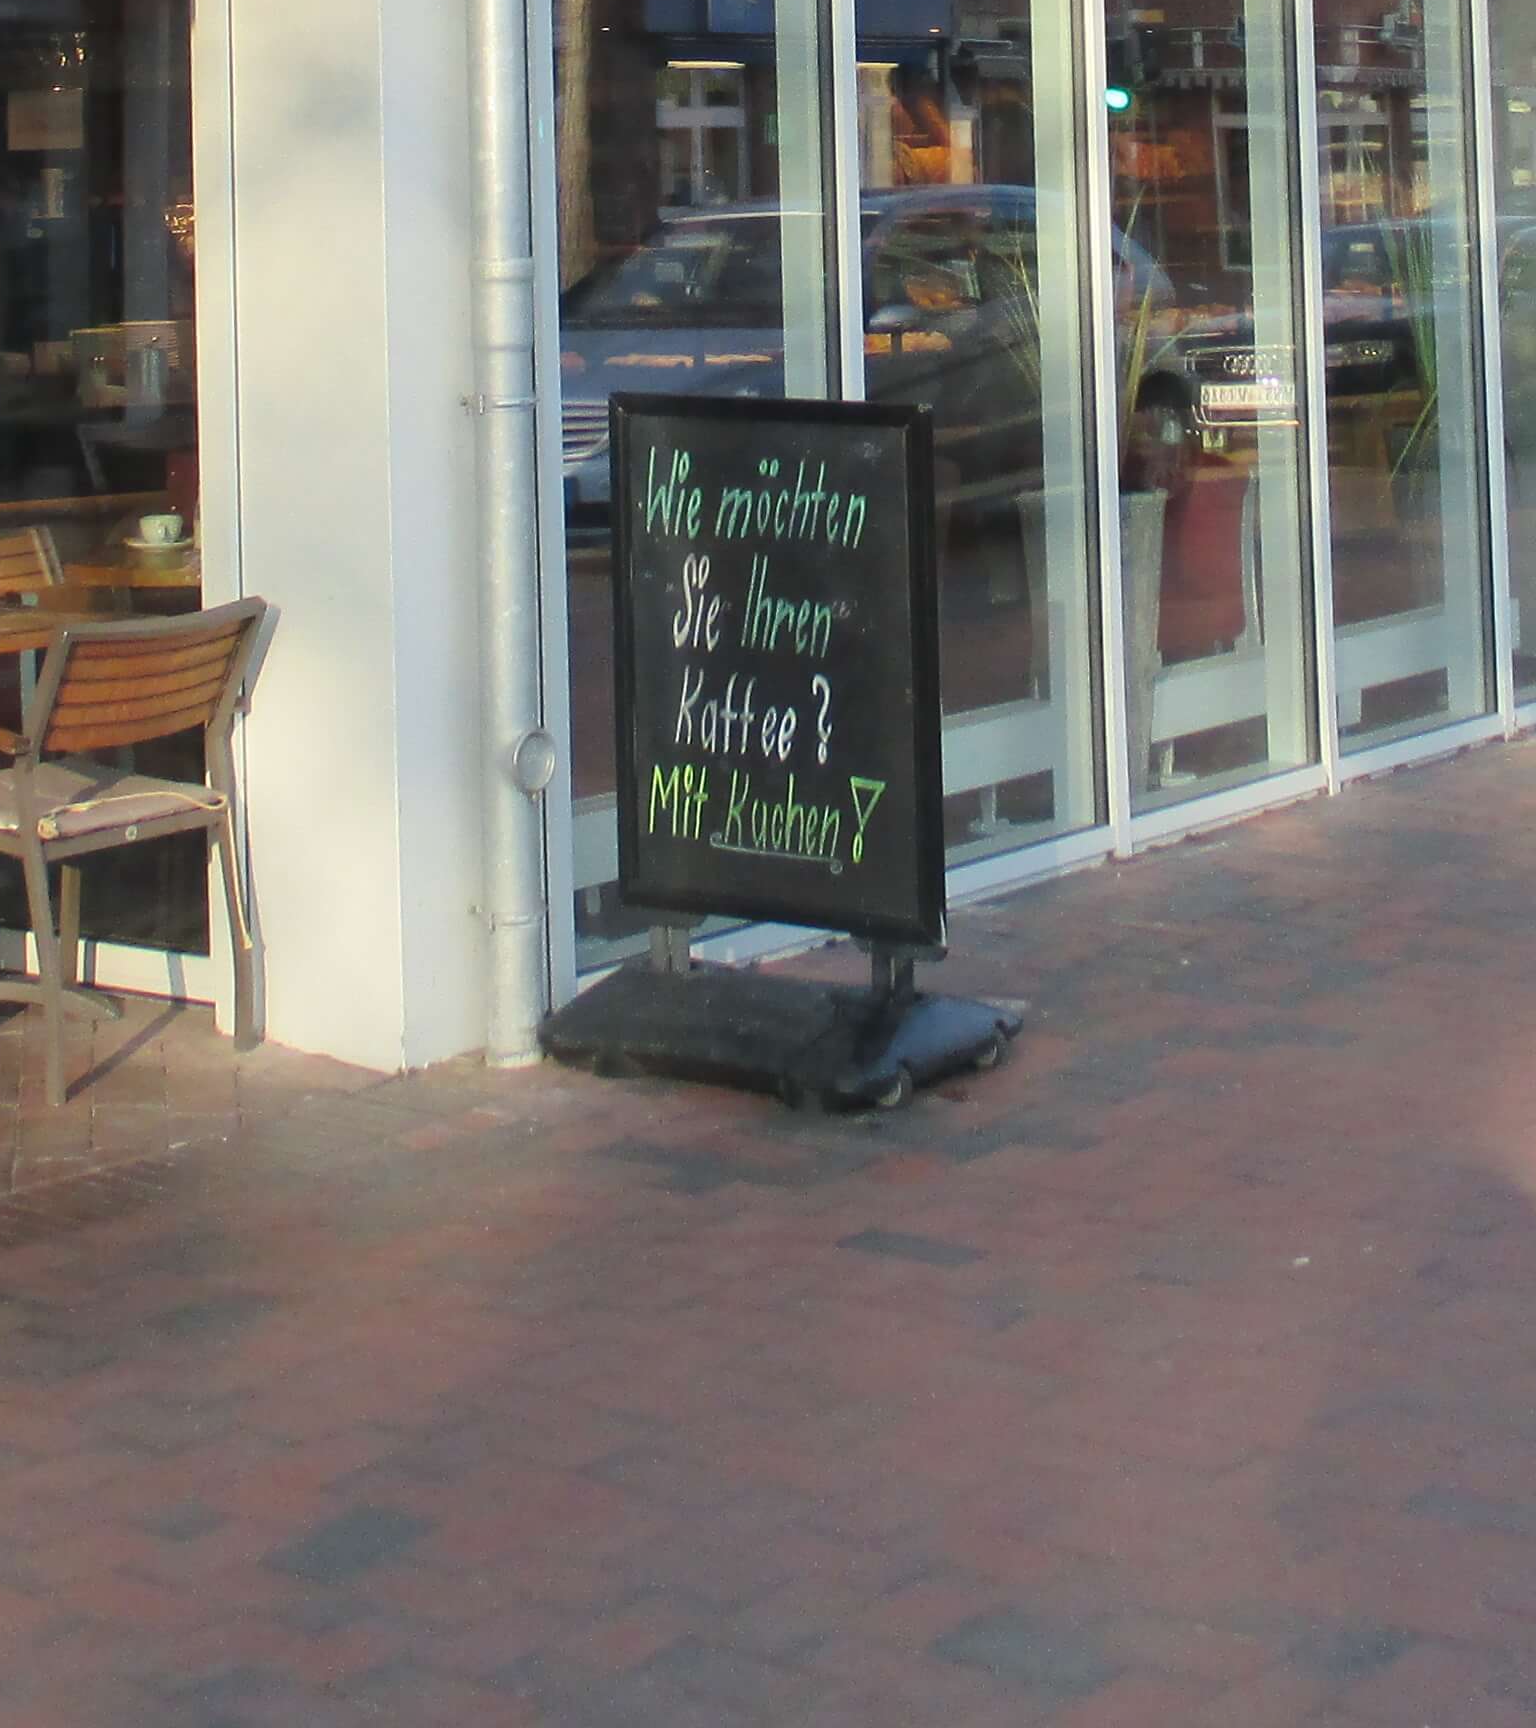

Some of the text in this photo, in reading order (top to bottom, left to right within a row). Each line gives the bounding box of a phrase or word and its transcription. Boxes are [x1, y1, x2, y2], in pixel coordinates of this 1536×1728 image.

[644, 445, 866, 549] Wie möchten
[672, 552, 833, 658] Sie Ihren
[648, 763, 710, 841] Mit
